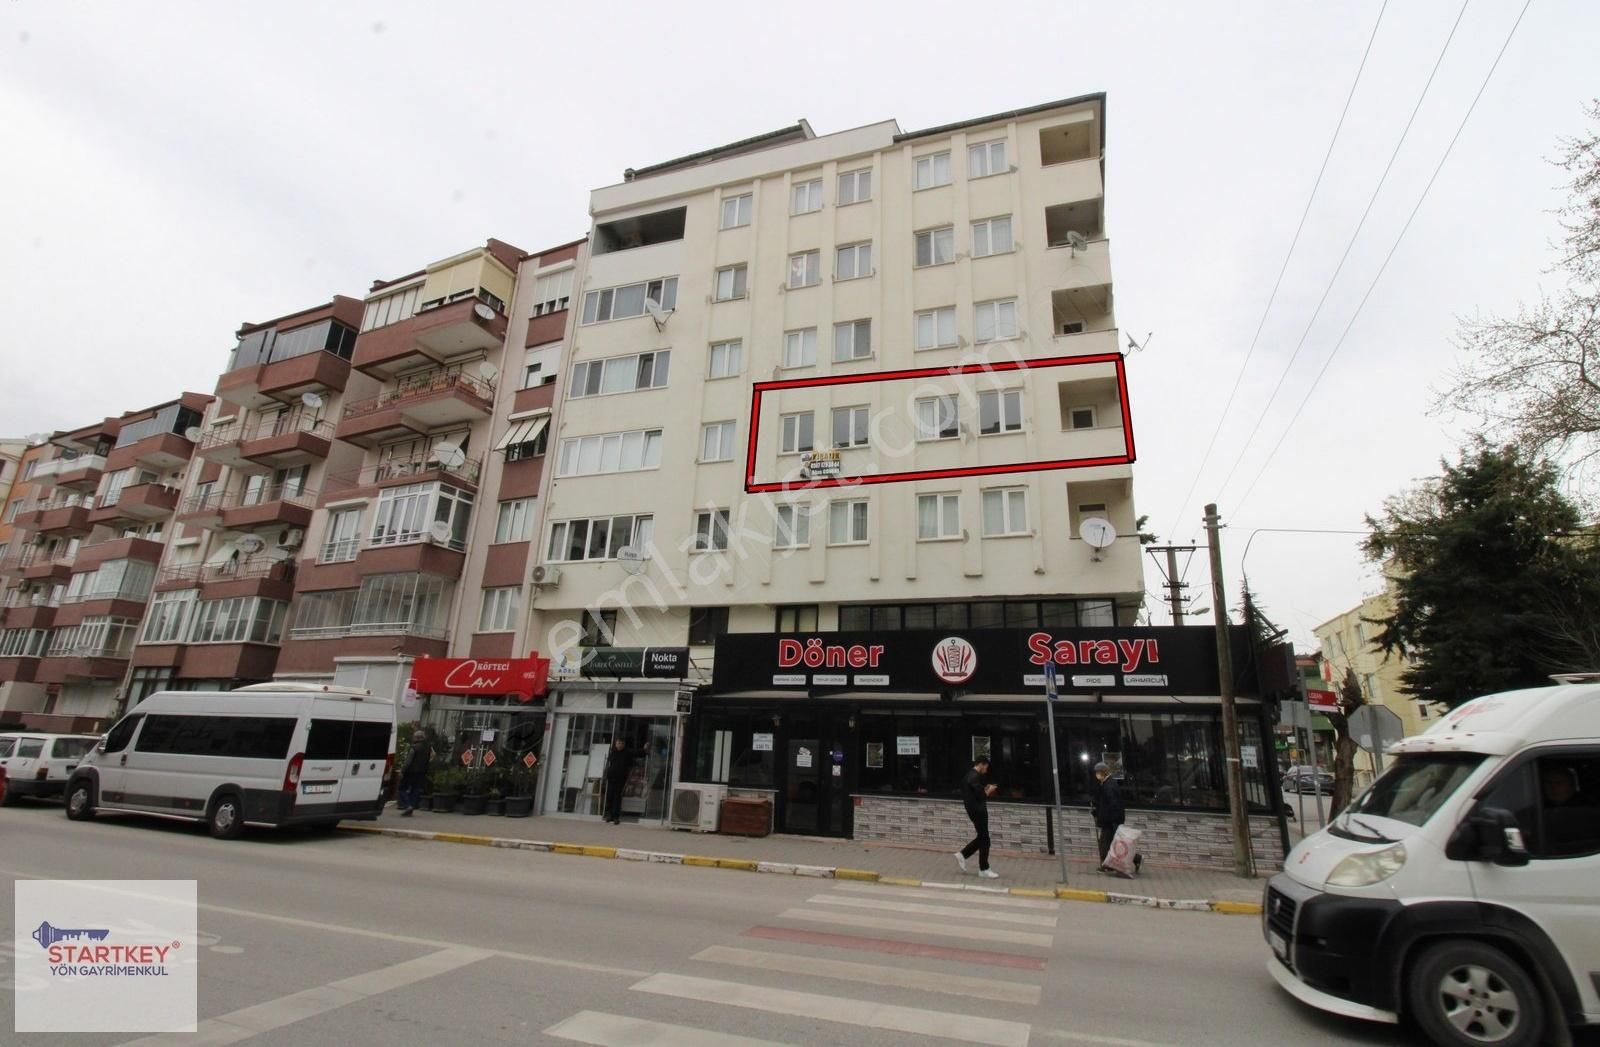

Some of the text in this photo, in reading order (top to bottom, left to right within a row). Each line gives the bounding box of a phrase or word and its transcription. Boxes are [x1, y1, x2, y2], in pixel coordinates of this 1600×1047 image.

[651, 653, 678, 663] Nokta
[778, 638, 884, 668] Döner
[1028, 632, 1159, 672] Sarayı
